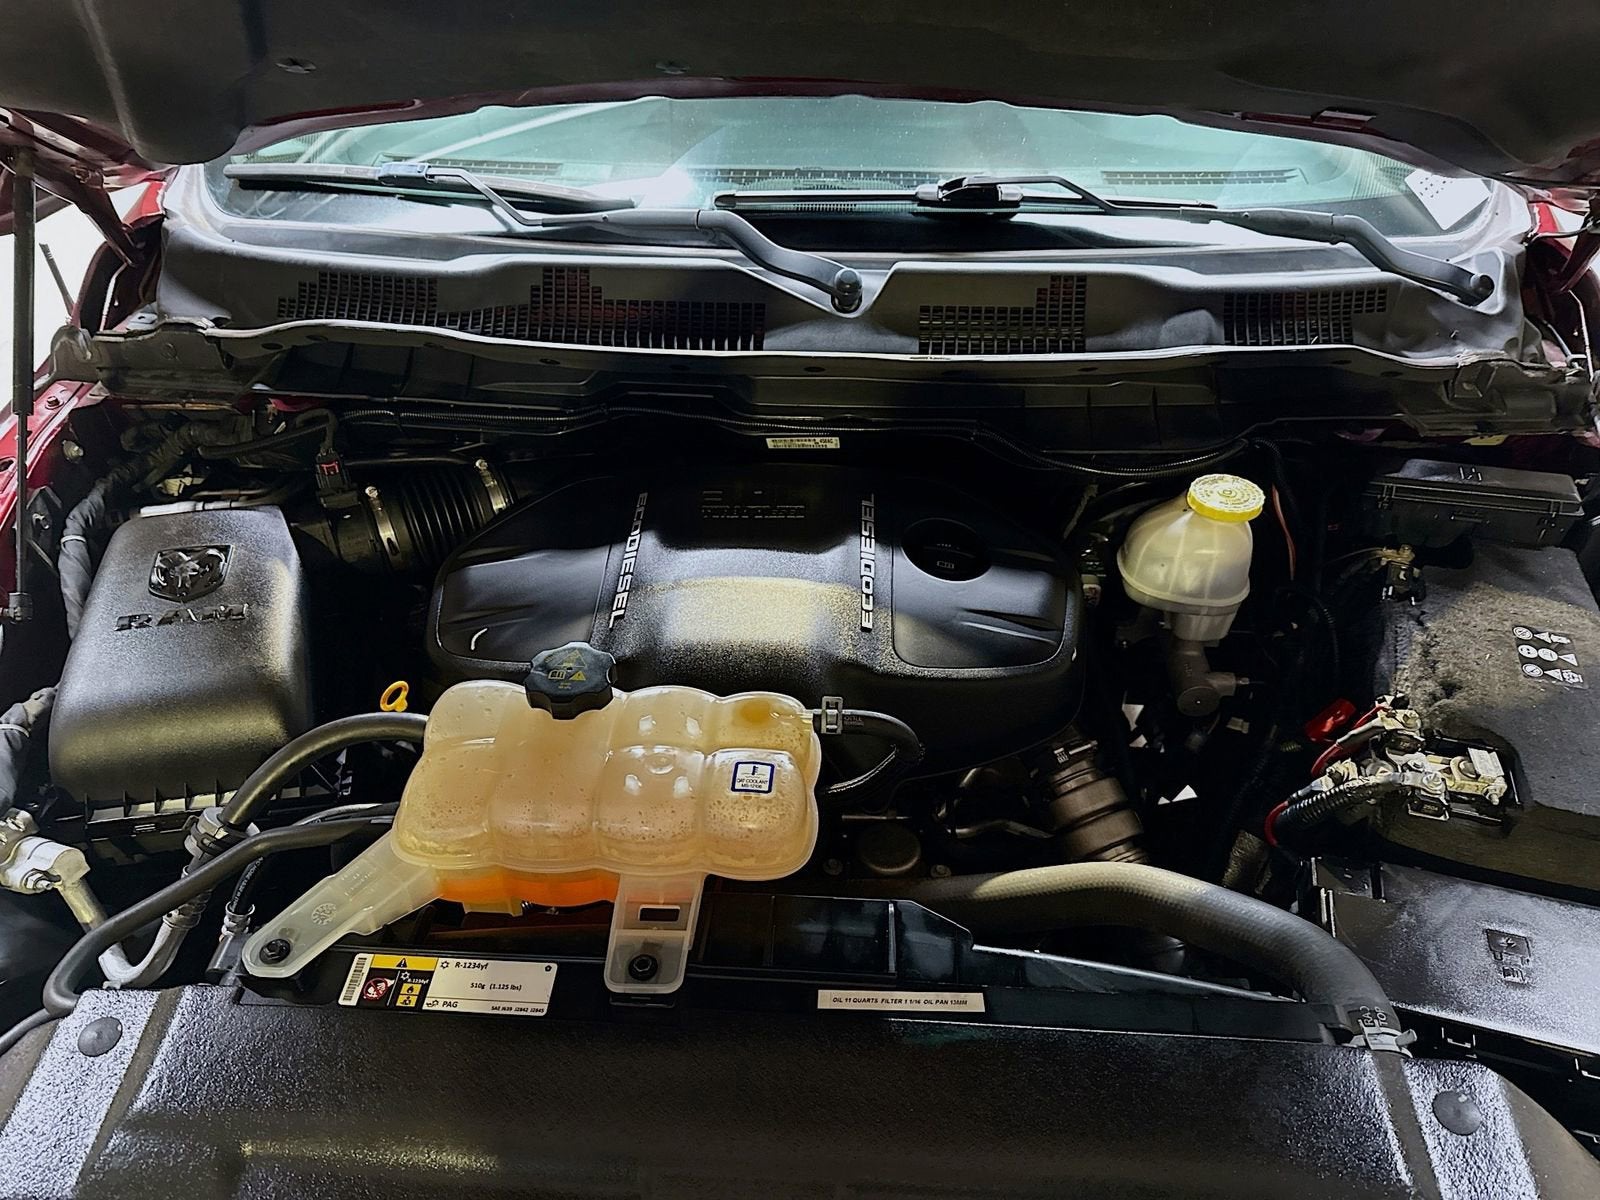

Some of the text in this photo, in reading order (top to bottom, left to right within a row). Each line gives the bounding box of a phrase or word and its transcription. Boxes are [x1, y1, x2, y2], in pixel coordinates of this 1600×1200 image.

[609, 492, 649, 629] ECODIESEL
[860, 493, 876, 629] ECODIESEL
[113, 603, 250, 632] RAM
[455, 962, 489, 971] R-1234yf
[470, 982, 486, 990] 510g
[510, 983, 522, 991] lbs)
[442, 1000, 458, 1008] PAG
[1374, 1005, 1388, 1026] TOP
